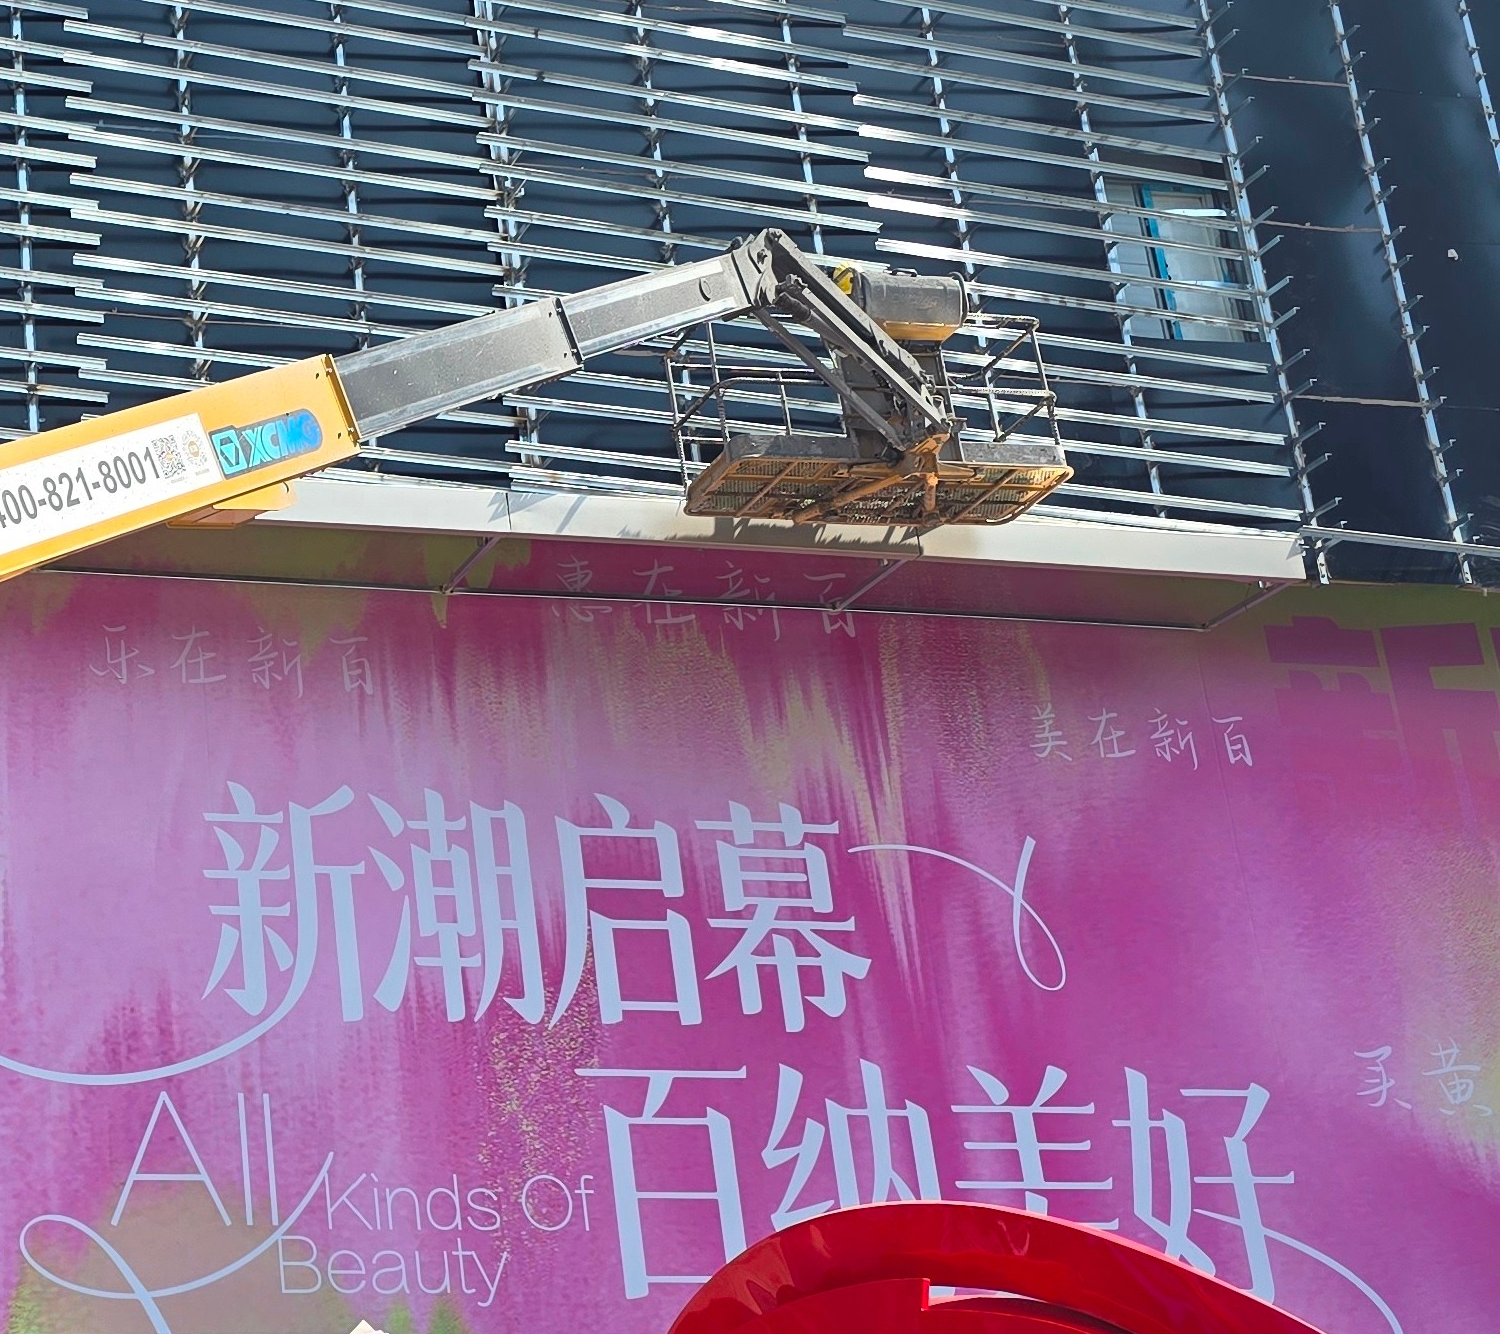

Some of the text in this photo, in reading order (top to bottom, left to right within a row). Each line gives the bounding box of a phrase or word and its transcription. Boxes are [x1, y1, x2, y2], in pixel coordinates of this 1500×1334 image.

[242, 412, 321, 467] XCMG
[1028, 704, 1255, 771] 美在新百
[202, 780, 872, 1034] 新潮启幕
[109, 1091, 595, 1232] All Kinds Of
[575, 1058, 1295, 1304] 百纳美好
[280, 1235, 509, 1308] Beauty
